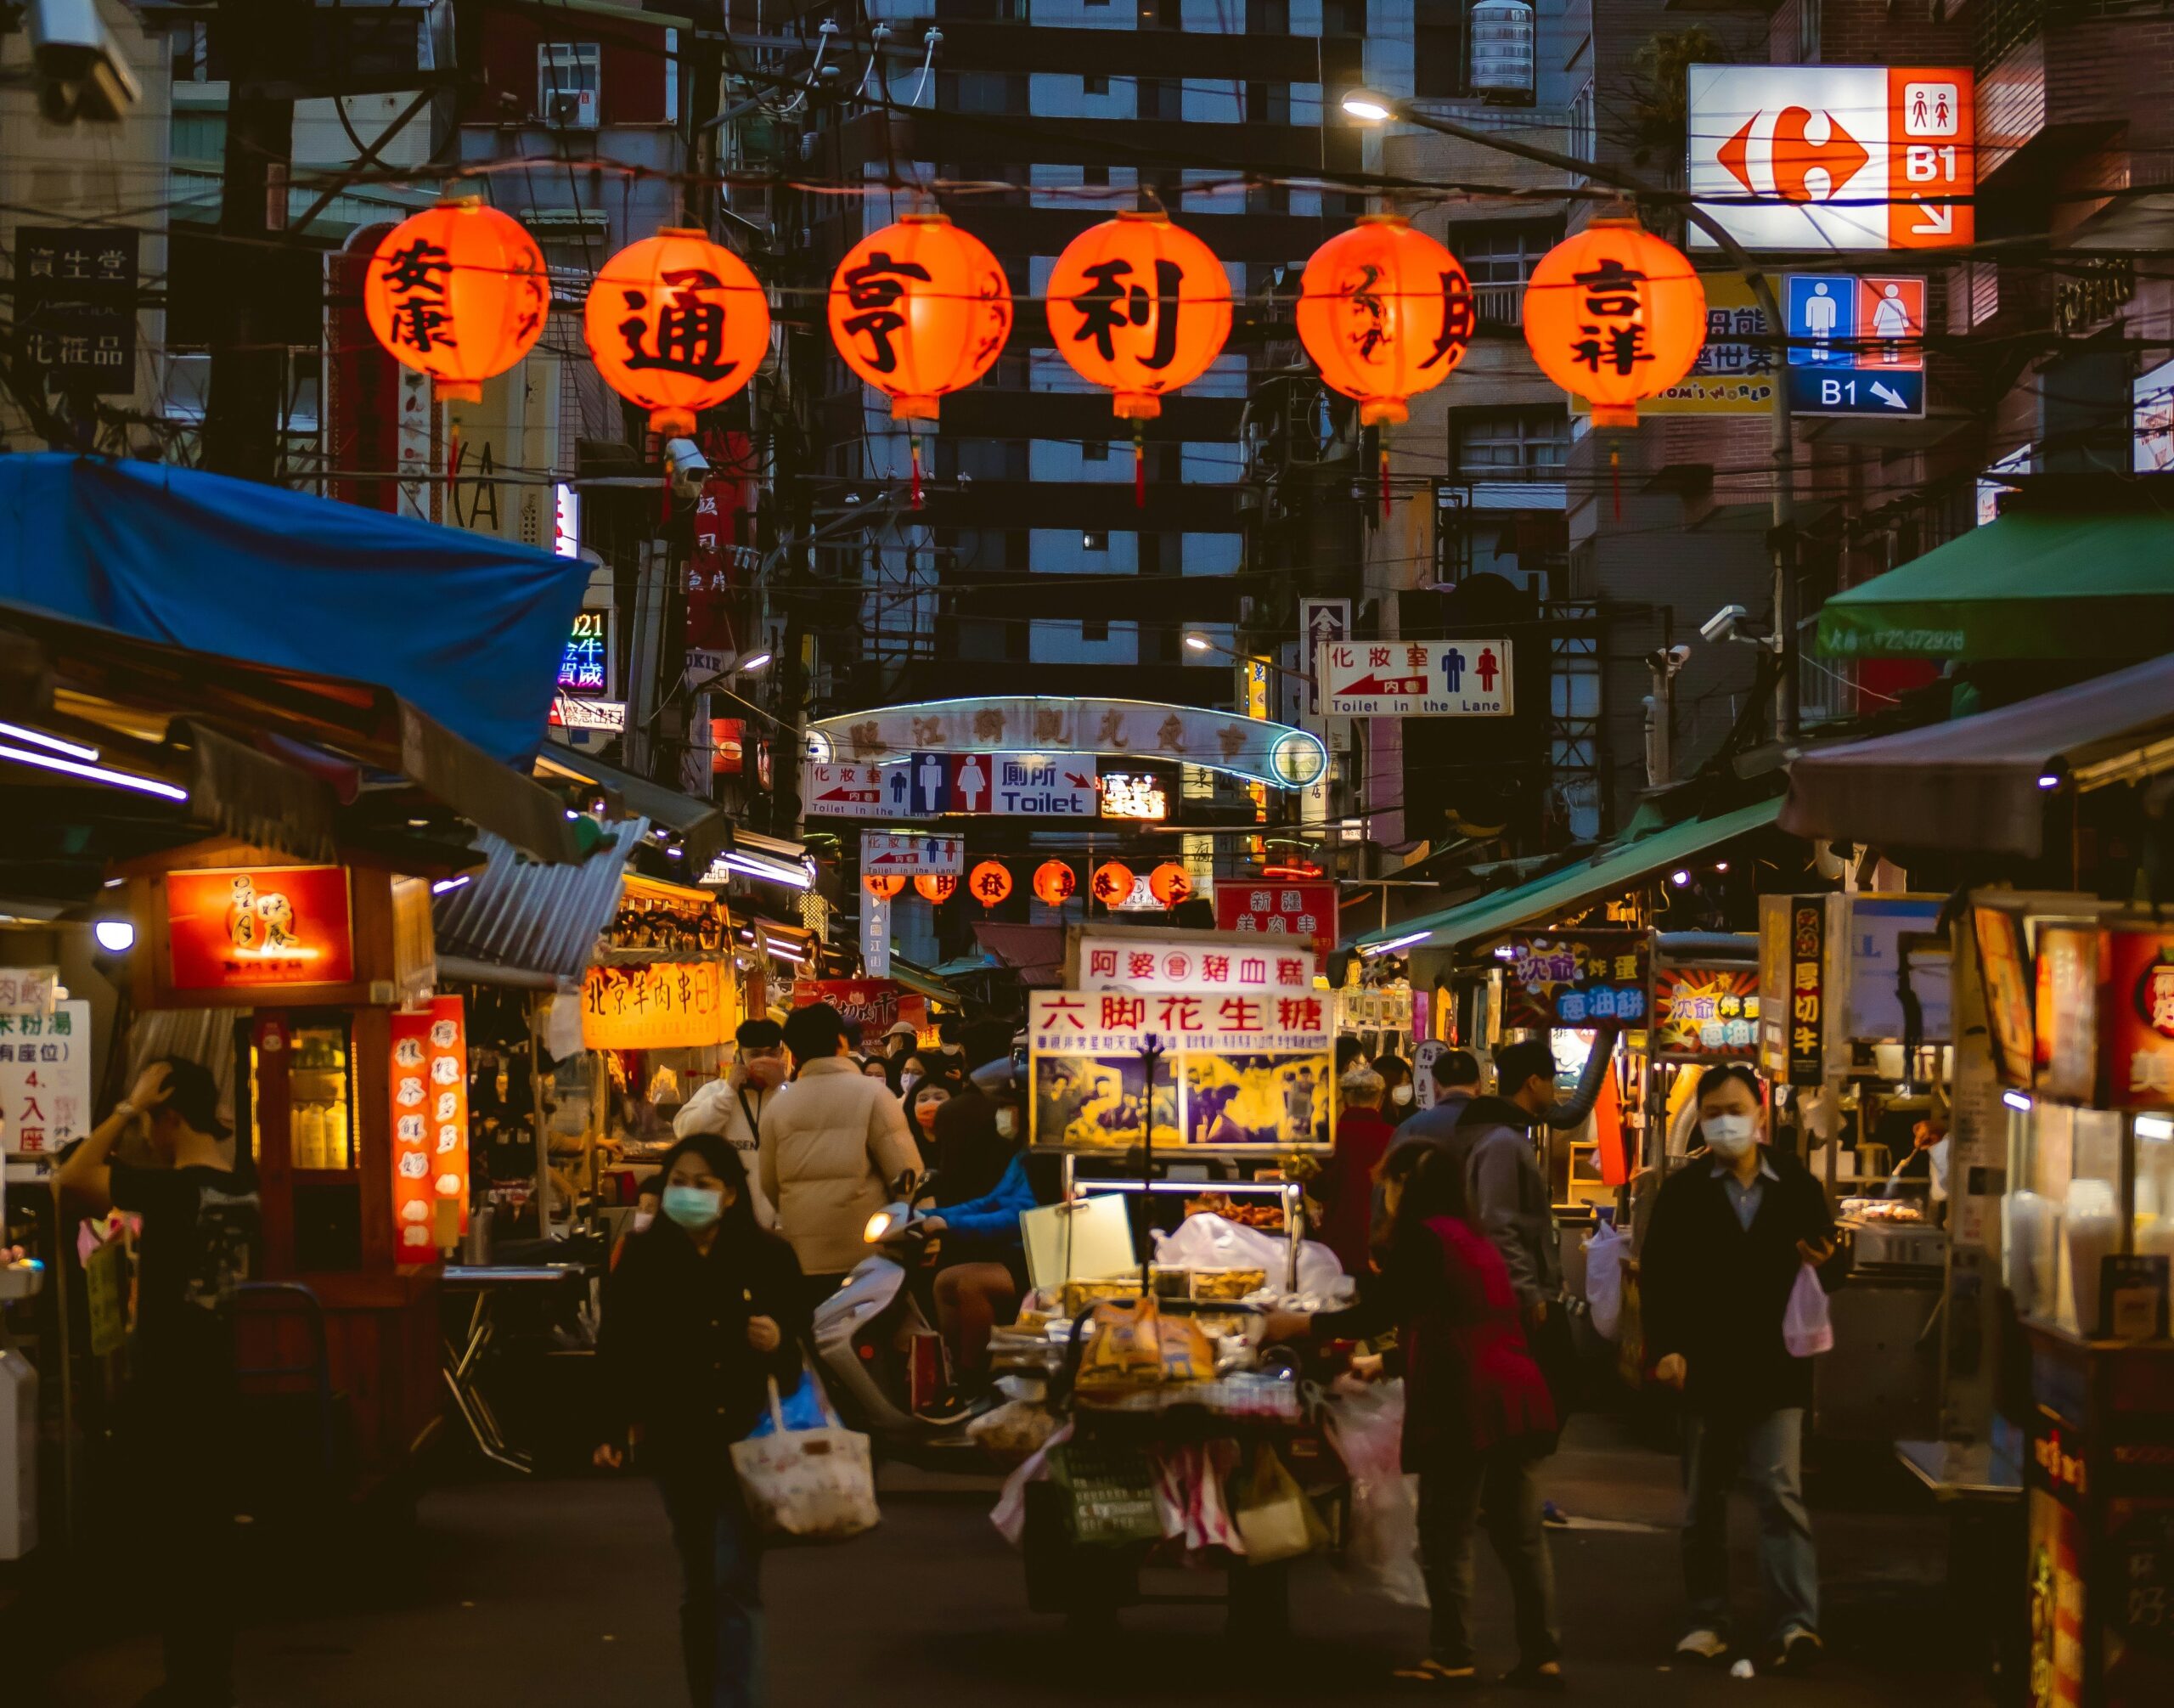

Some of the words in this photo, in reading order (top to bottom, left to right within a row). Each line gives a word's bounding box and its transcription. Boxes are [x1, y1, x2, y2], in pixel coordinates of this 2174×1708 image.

[1906, 145, 1956, 182] B1
[382, 239, 457, 352] 安康
[619, 268, 739, 382] 通
[842, 252, 932, 374] 亨
[1071, 258, 1184, 369] 利
[1571, 259, 1657, 375] 吉祥
[1709, 386, 1771, 402] WORLD
[1821, 379, 1857, 405] B1
[1332, 648, 1428, 668] 化妝室
[1332, 699, 1379, 713] Toilet
[1394, 699, 1409, 713] in
[1423, 699, 1449, 713] the
[1462, 699, 1501, 713] Lane
[814, 767, 882, 785] 化妝室
[812, 803, 845, 815] Toilet
[854, 805, 866, 815] in
[876, 808, 893, 817] the
[1001, 792, 1084, 814] Toilet
[1251, 891, 1302, 912] 新疆
[1236, 913, 1316, 935] 羊肉串
[589, 971, 691, 1016] 北京羊肉串
